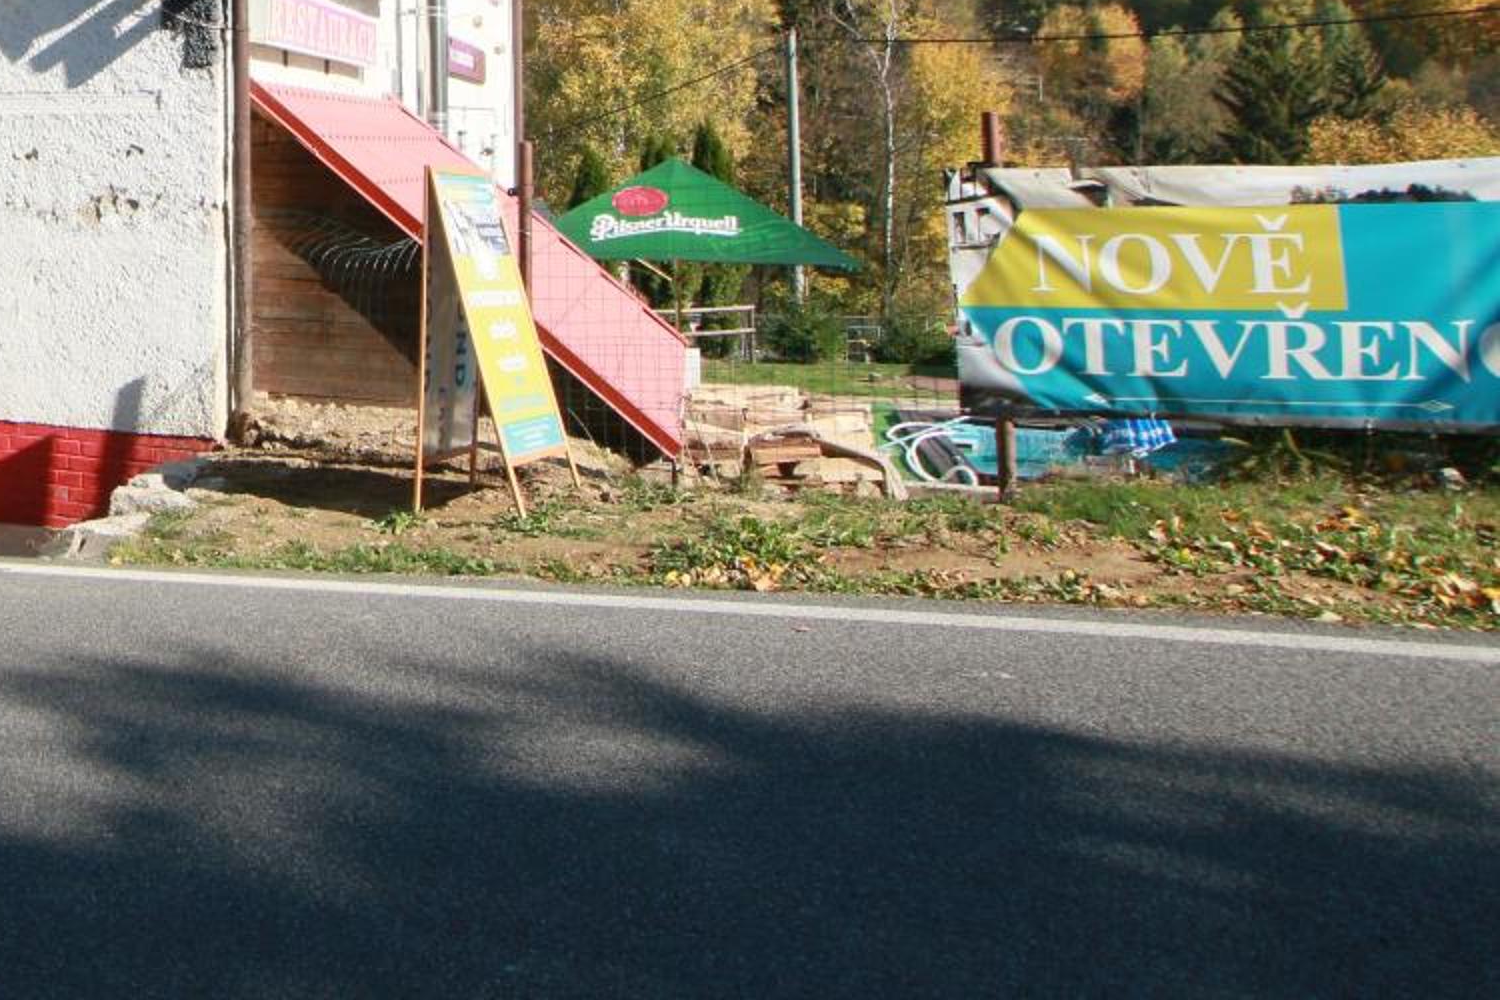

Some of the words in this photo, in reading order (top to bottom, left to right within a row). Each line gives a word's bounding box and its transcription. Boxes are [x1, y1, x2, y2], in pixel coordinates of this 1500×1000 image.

[589, 213, 665, 241] Pilsner
[663, 210, 740, 236] Urquell
[1030, 214, 1313, 296] NOVĚ
